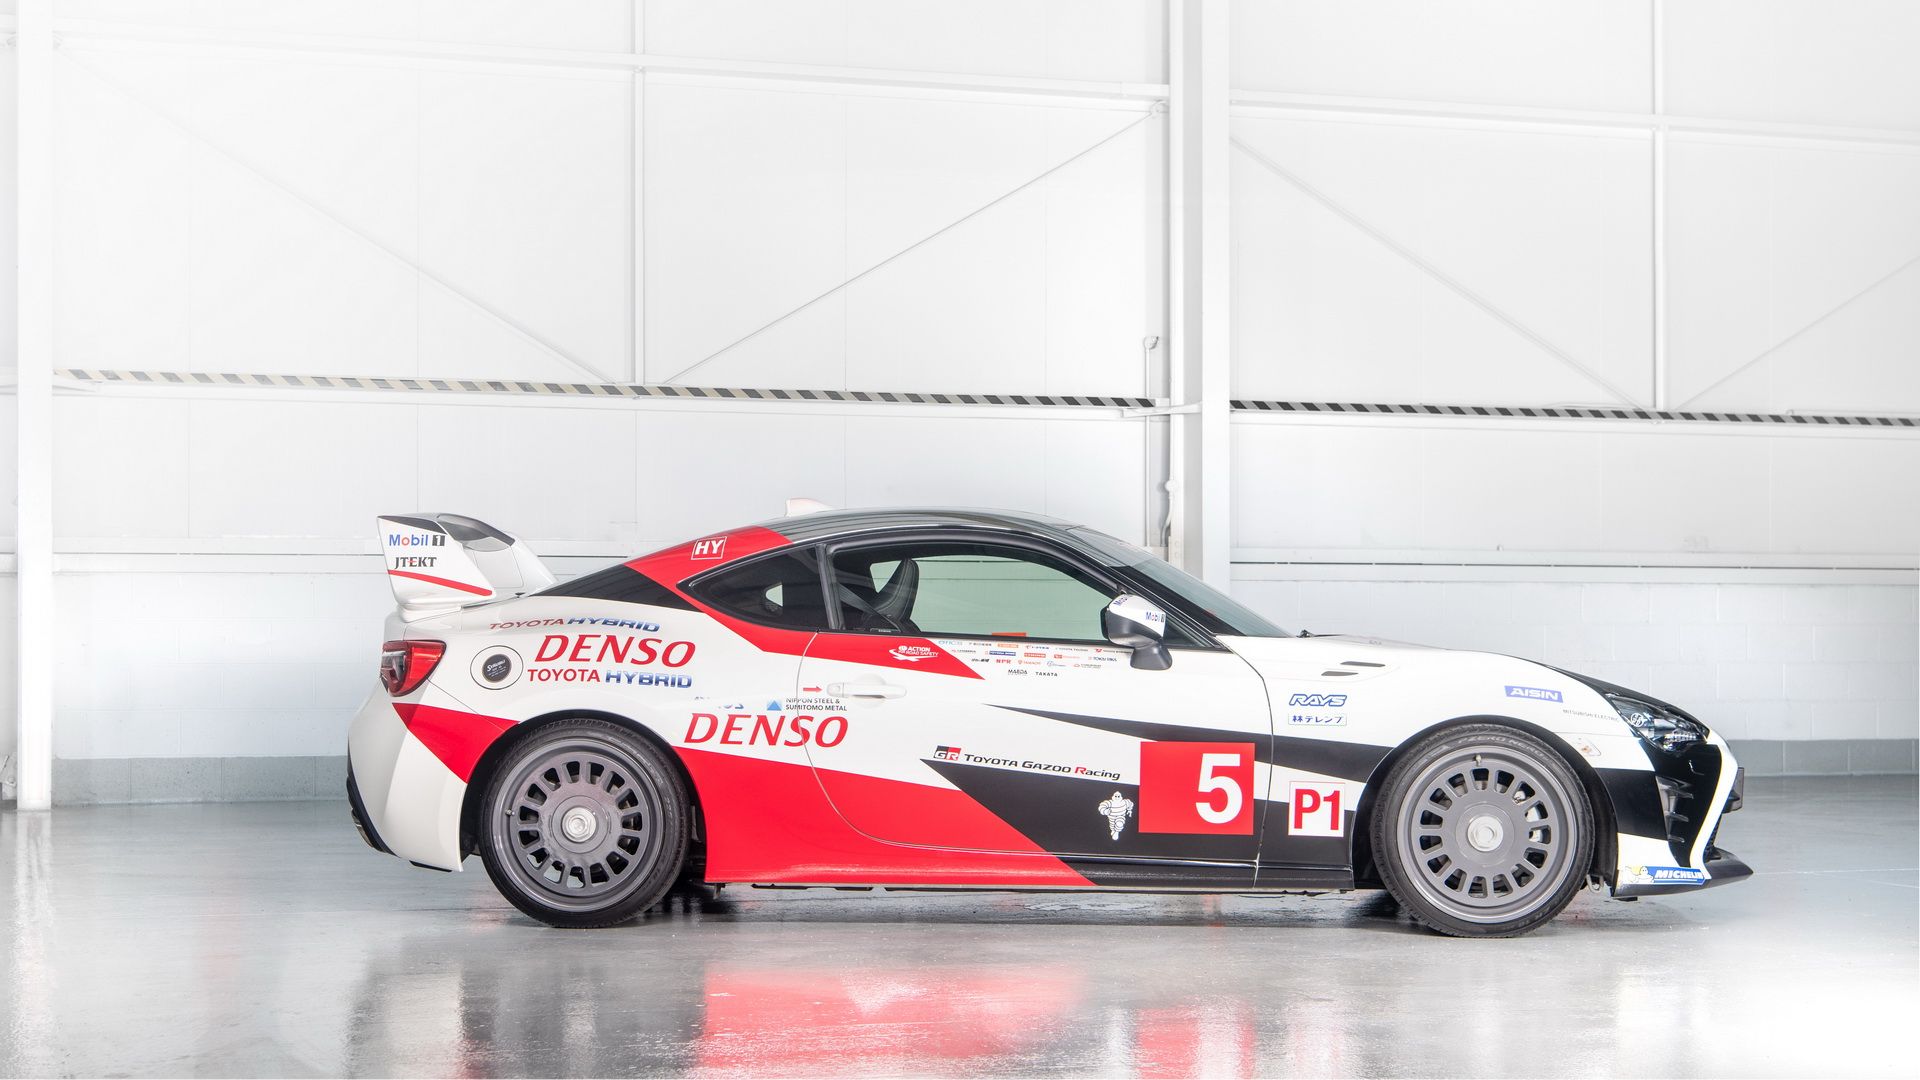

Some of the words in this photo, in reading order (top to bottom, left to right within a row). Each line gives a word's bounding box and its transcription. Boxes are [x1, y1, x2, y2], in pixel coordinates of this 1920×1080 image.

[389, 534, 428, 546] Mobil
[695, 540, 724, 555] HY
[395, 557, 437, 569] JTEKT
[489, 618, 565, 630] TOYOTA
[567, 617, 661, 633] HYBRID
[534, 634, 696, 668] DENSO
[527, 668, 600, 682] TOYOTA
[605, 670, 693, 689] HYBRID
[1289, 693, 1347, 707] RAYS
[1510, 687, 1559, 700] AISIN
[683, 712, 849, 748] DENSO
[933, 749, 961, 761] GR
[964, 753, 1018, 767] TOYOTA
[1021, 760, 1072, 773] GAZOO
[1074, 766, 1121, 781] Racing
[1195, 753, 1242, 824] 5
[1294, 788, 1340, 831] P1
[1654, 869, 1704, 879] MICHELIN
